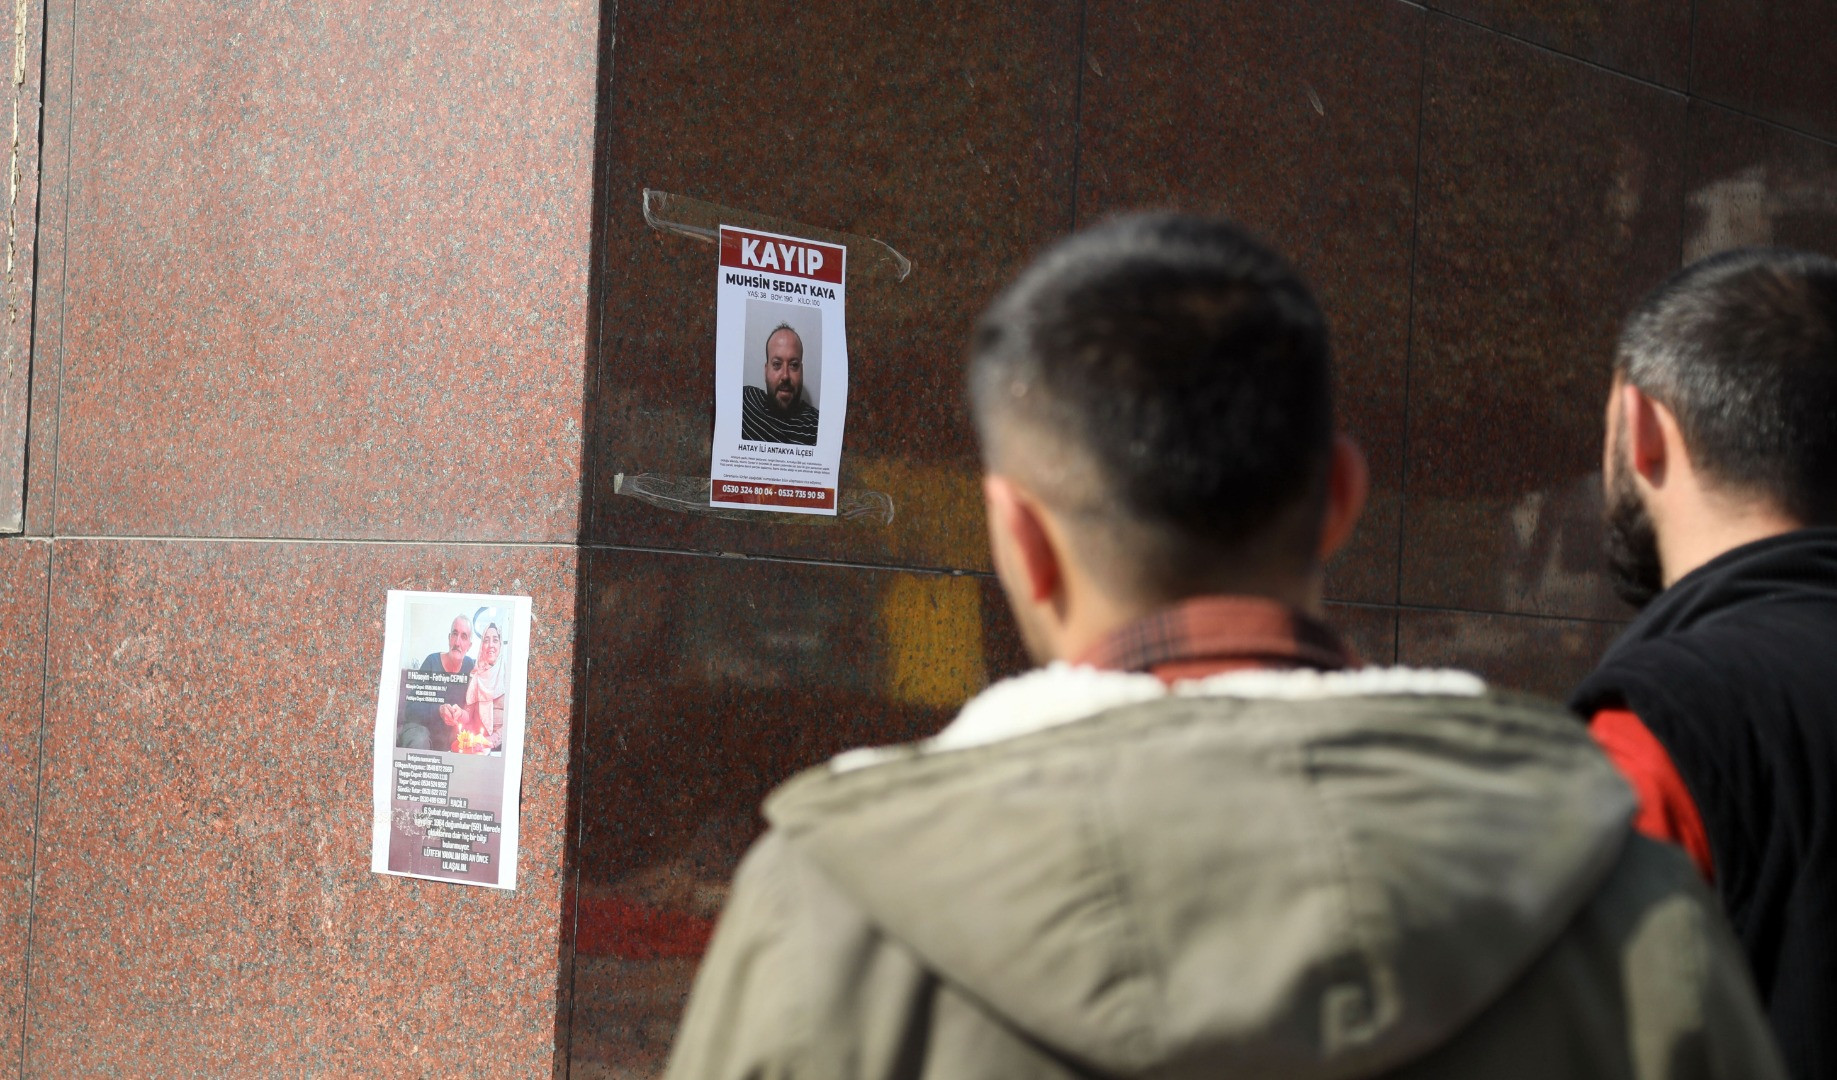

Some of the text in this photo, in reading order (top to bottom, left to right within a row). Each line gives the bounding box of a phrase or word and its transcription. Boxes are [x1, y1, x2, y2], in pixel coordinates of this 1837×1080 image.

[741, 237, 824, 276] KAYIP
[726, 273, 836, 300] MUHSİN SEDAT KAYA
[738, 443, 814, 458] HATAY İLİ ANTAKYA İLÇESİ
[722, 484, 740, 494] 0530
[740, 486, 754, 495] 324
[754, 486, 764, 496] 80
[764, 487, 774, 497] 04
[778, 488, 794, 498] 0532
[794, 489, 806, 499] 735
[807, 490, 816, 500] 90
[816, 490, 826, 500] 58
